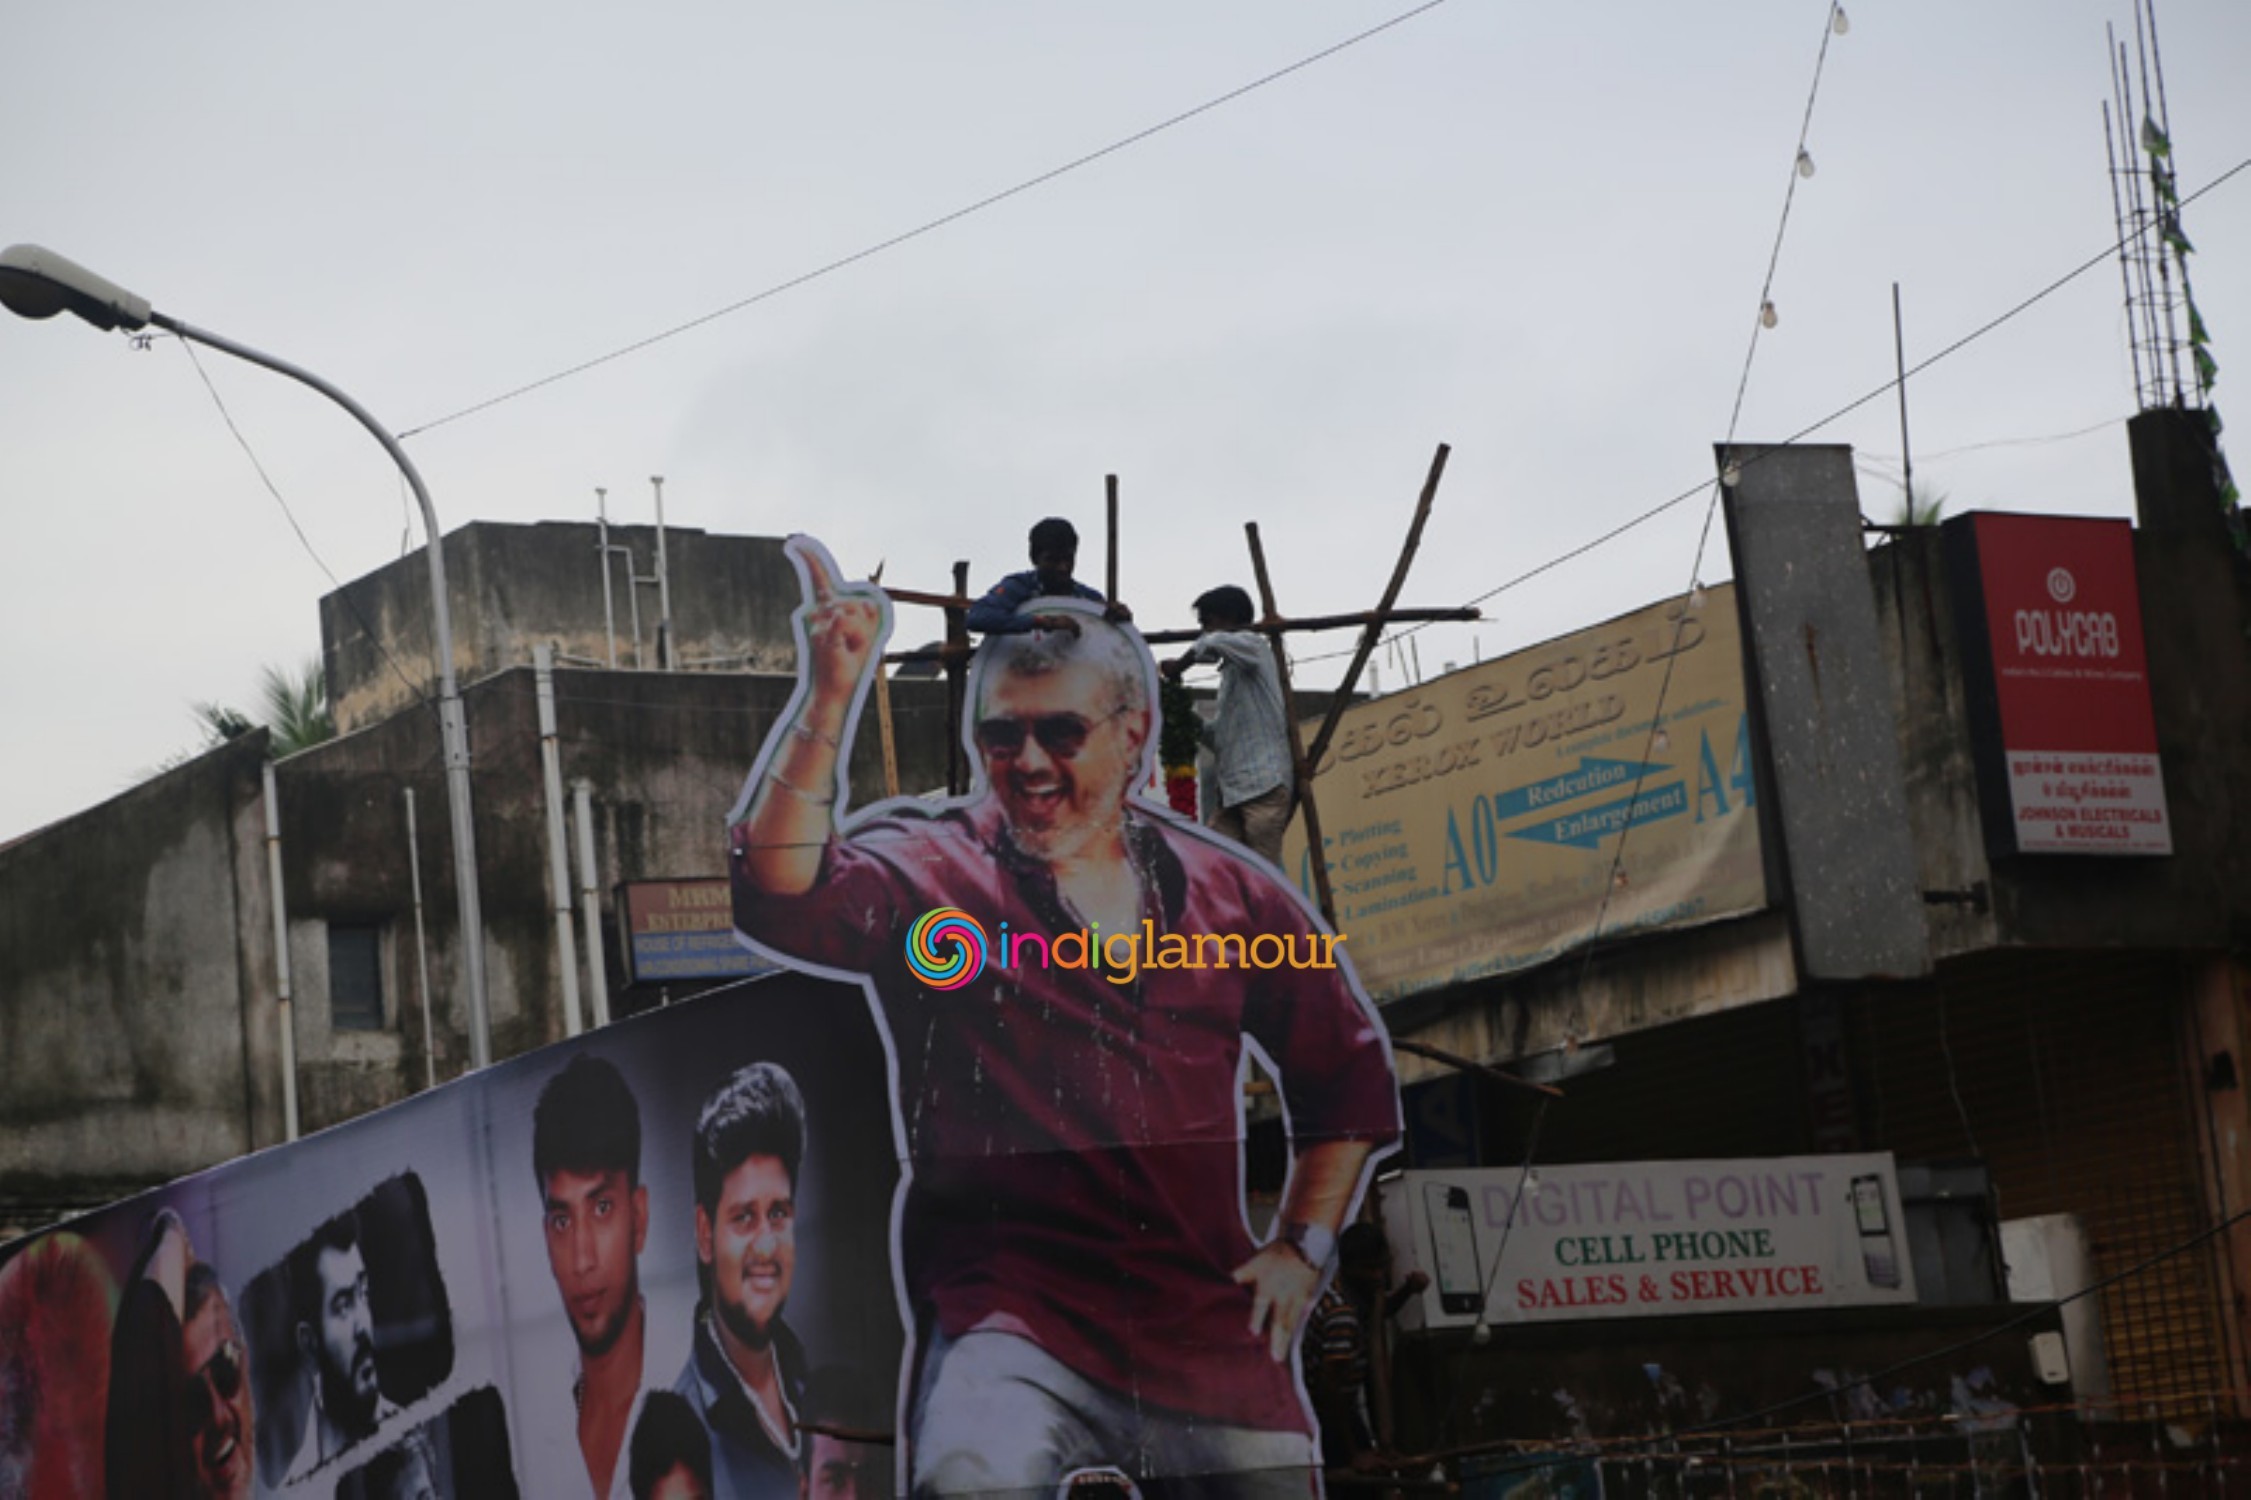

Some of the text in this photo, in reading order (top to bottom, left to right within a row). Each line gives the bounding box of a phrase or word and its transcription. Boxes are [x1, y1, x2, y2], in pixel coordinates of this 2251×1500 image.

[2014, 609, 2119, 658] POLYCAB
[1496, 695, 1626, 758] WORLD
[1554, 790, 1683, 841] Enlargement
[2080, 806, 2161, 824] ELECTRICALS
[1340, 841, 1408, 872] Copying
[1342, 865, 1418, 896] Scanning
[1344, 882, 1438, 922] Lamination
[1481, 1172, 1826, 1230] DIGITAL POINT
[1554, 1227, 1776, 1267] CELL PHONE
[1516, 1264, 1824, 1310] SALES & SERVICE
